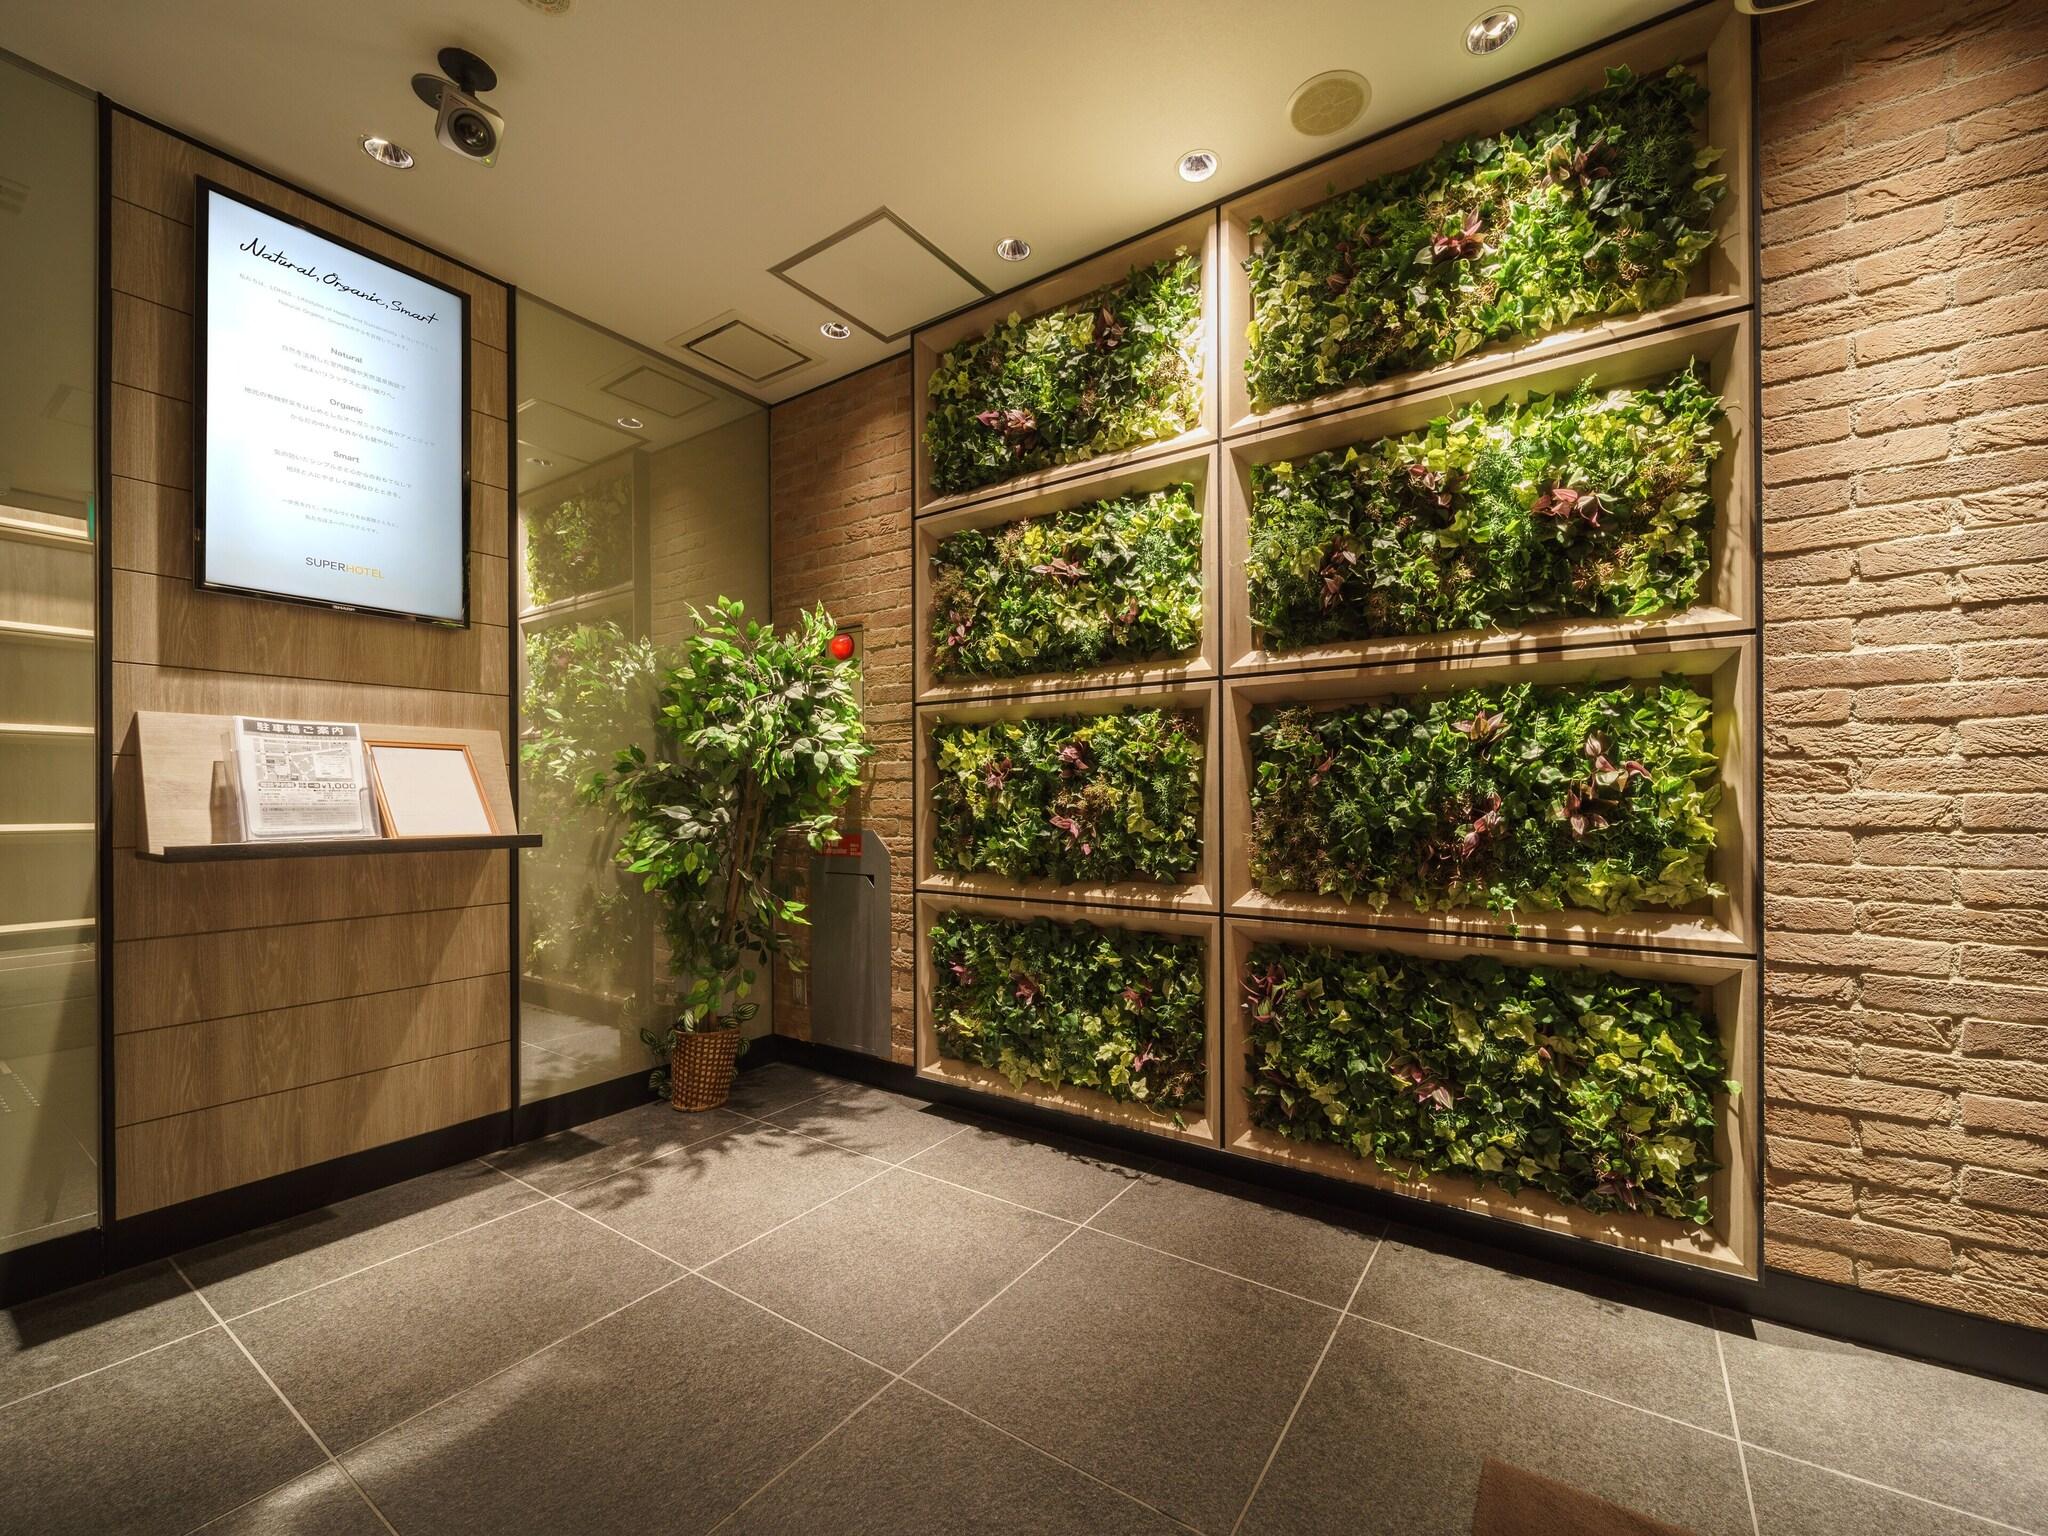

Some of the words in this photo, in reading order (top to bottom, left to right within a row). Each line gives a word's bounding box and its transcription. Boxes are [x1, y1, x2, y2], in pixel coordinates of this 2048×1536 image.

[391, 300, 439, 325] Smart
[330, 347, 363, 364] Natural
[329, 398, 364, 415] Organic
[333, 450, 360, 464] Smart
[305, 556, 385, 579] SUPERHOTEL
[256, 721, 344, 736] 駐車場ご案内
